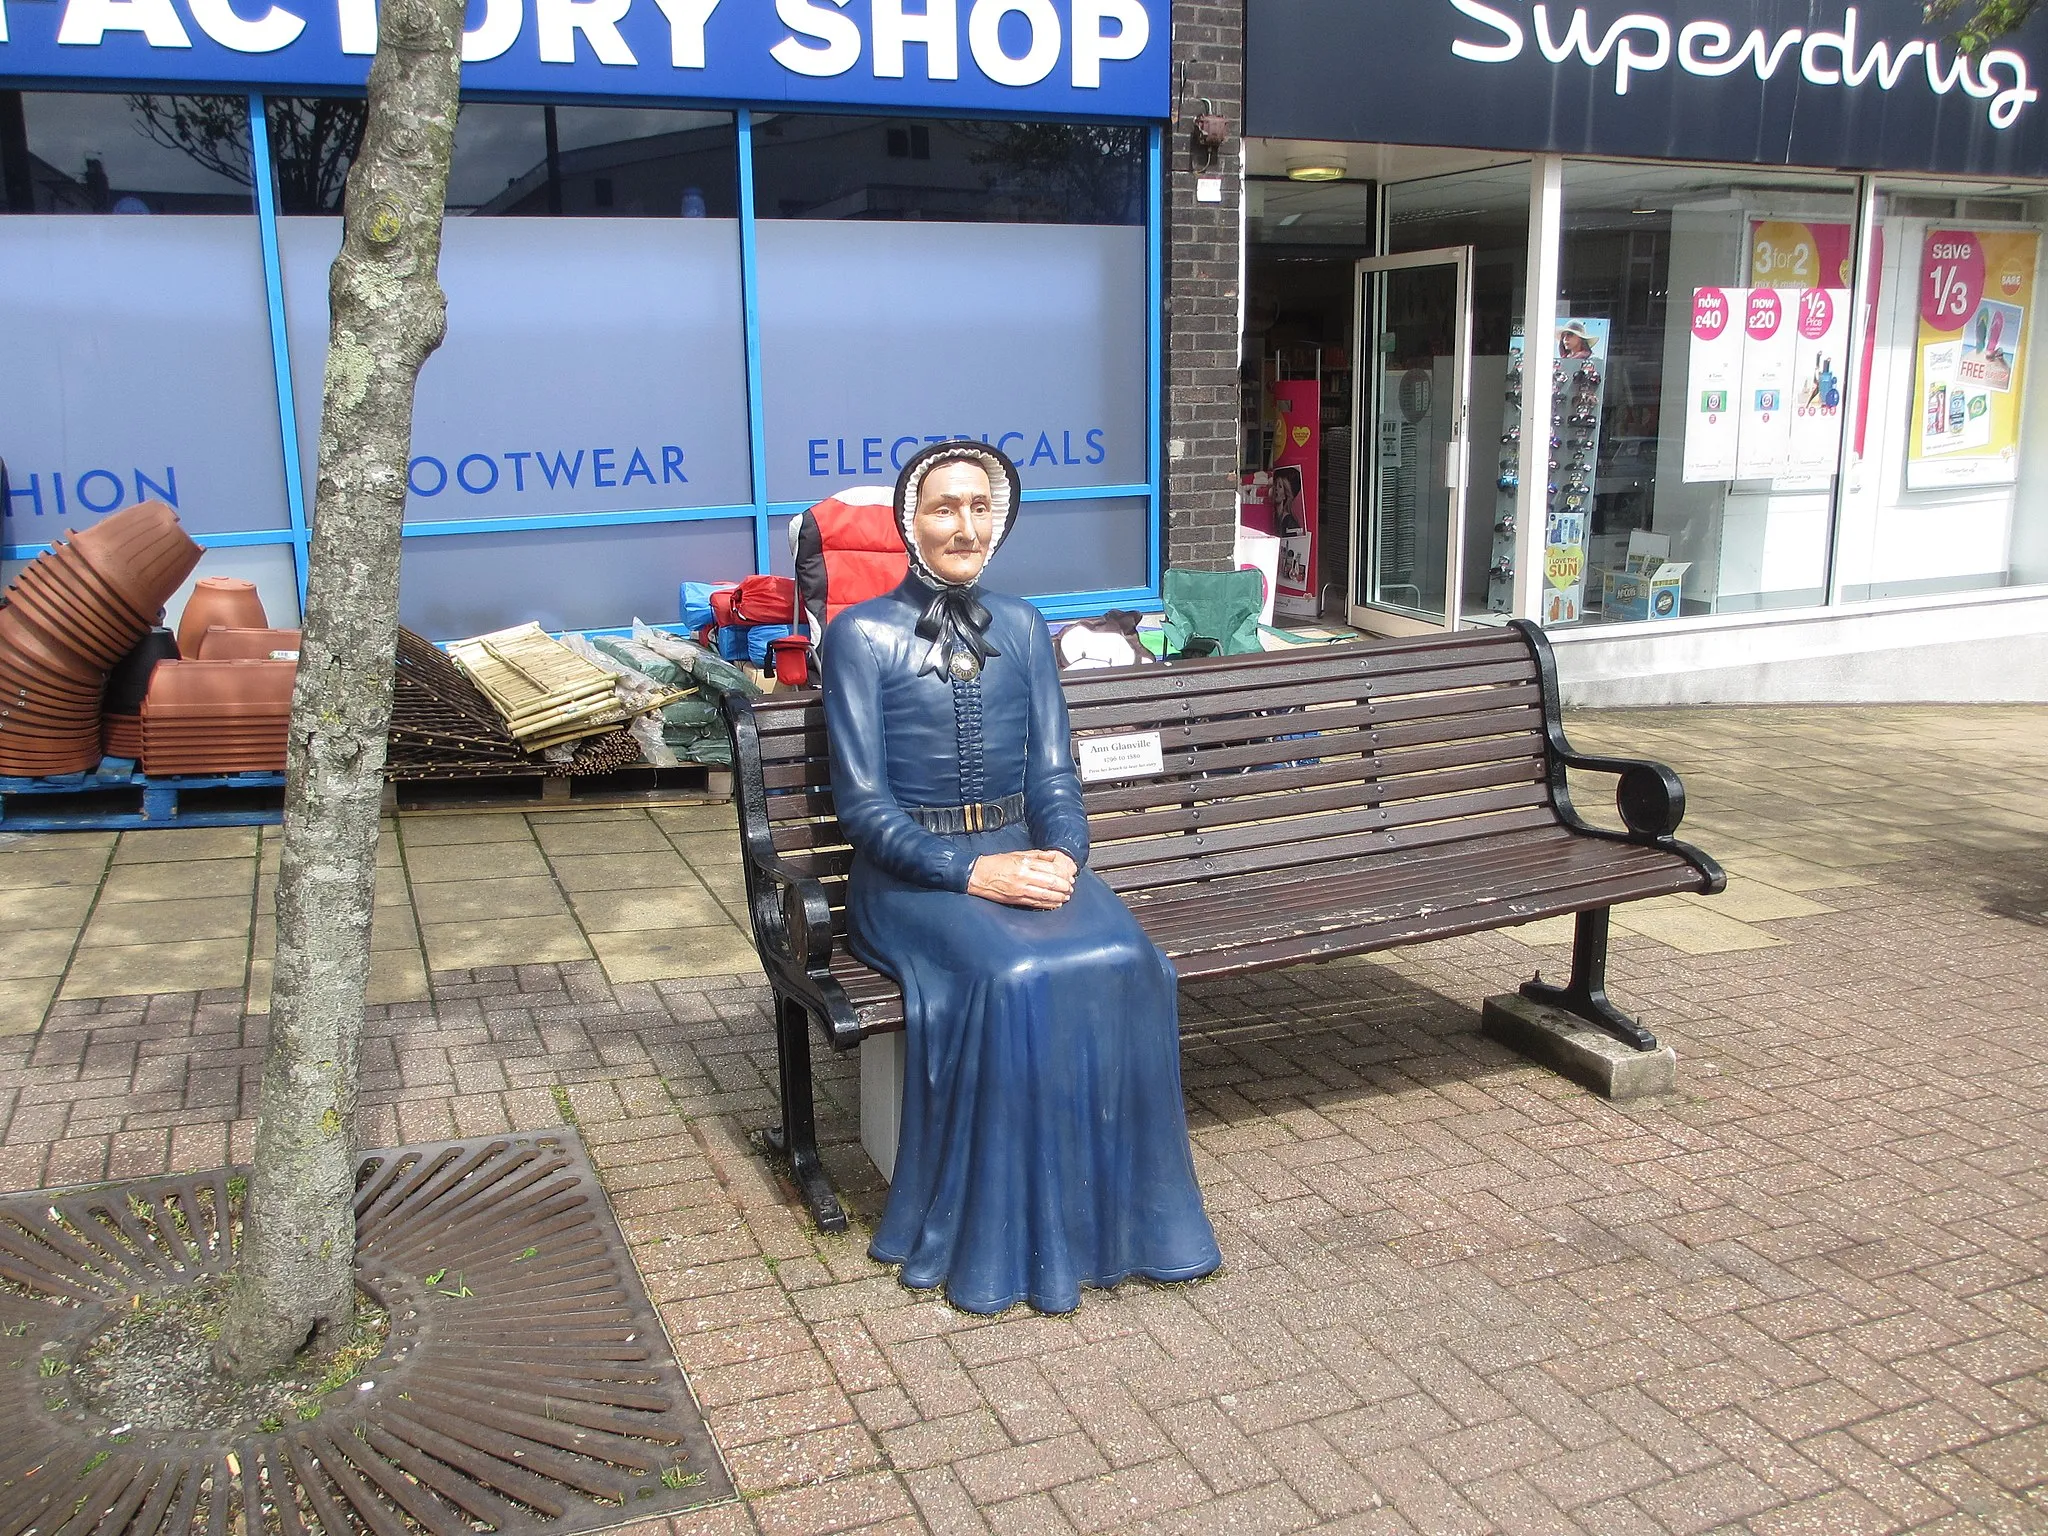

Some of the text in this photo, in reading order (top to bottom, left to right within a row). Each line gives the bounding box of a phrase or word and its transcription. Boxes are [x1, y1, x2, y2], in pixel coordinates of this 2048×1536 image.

[769, 0, 1150, 88] SHOP
[1450, 0, 2038, 130] Superdrug
[1932, 244, 1971, 259] save
[1930, 266, 1967, 316] 1/3
[1698, 297, 1722, 309] now
[1752, 298, 1775, 309] now
[1805, 292, 1826, 318] 1/2
[1695, 310, 1722, 329] £40
[1749, 310, 1775, 329] £20
[1805, 317, 1823, 327] Price
[1960, 361, 1985, 379] FREE
[808, 428, 1106, 477] ELECCALS
[408, 445, 689, 498] OOTWEAR
[4, 466, 179, 518] HION
[1549, 563, 1578, 577] SUN
[1090, 739, 1151, 754] Ann Glanville
